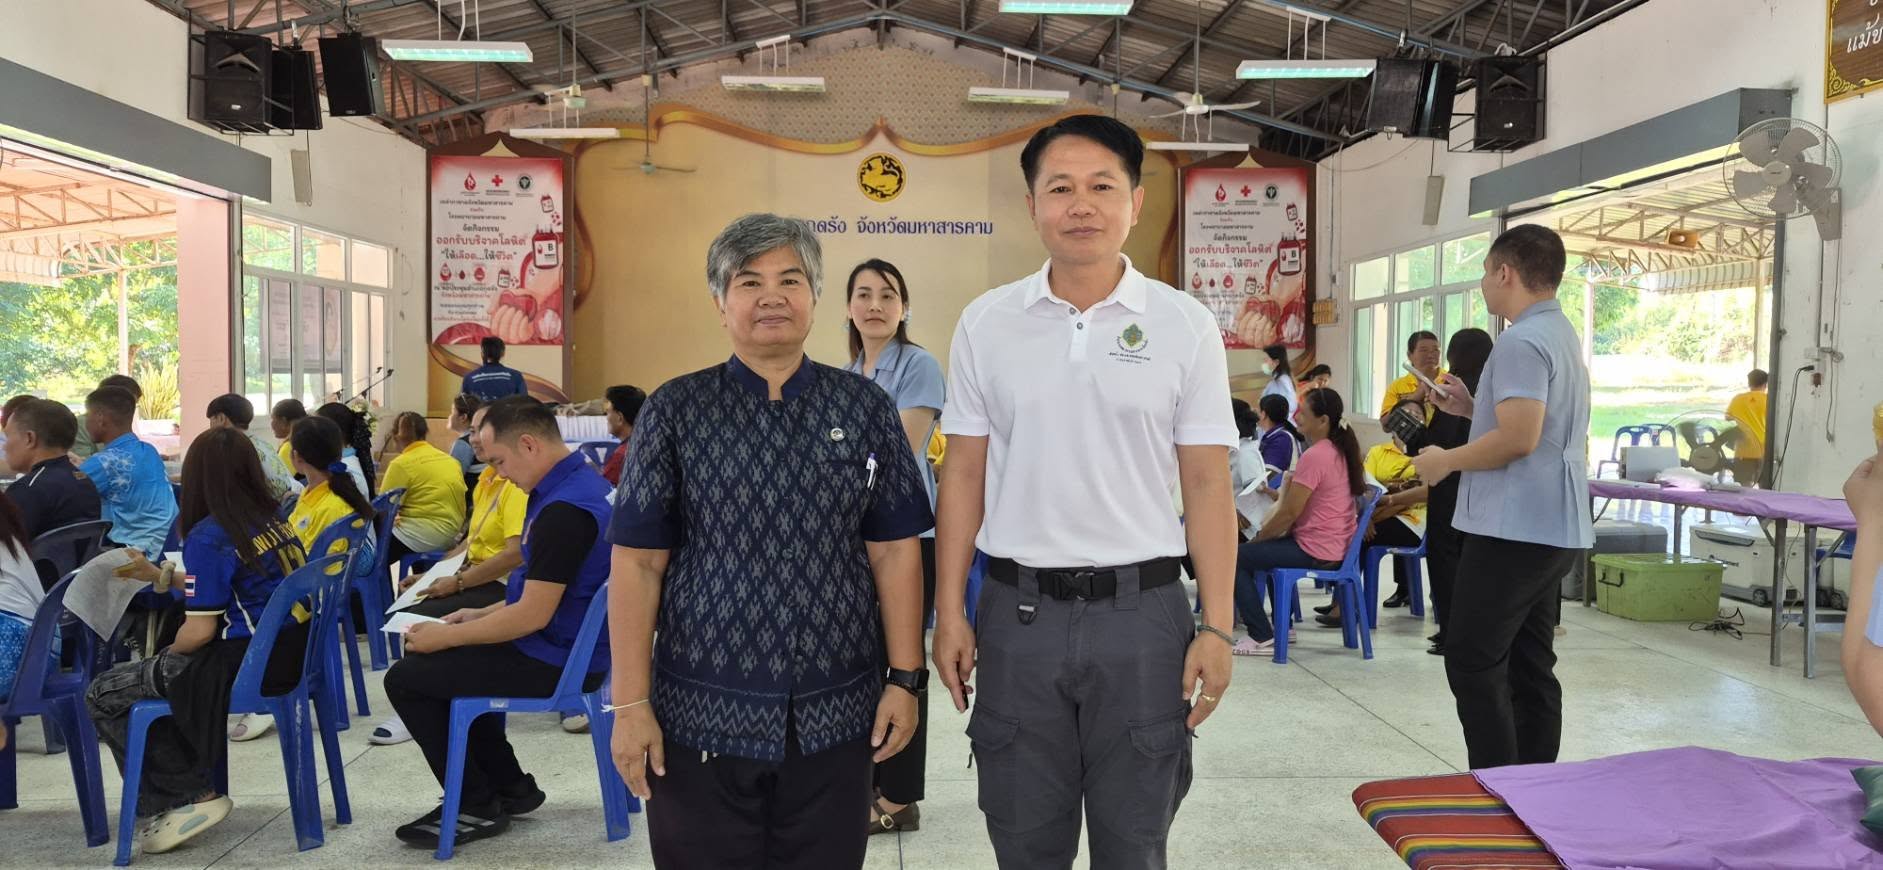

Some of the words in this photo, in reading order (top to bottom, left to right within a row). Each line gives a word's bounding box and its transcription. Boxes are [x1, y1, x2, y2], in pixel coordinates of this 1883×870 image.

[462, 223, 500, 232] จัดกิจกรรม
[857, 216, 993, 235] จังหวัดมหาสารคาม
[436, 233, 526, 246] ออกรับบริจาคโลหิต
[1213, 233, 1248, 241] จัดกิจกรรม
[1189, 242, 1272, 254] ออกรับบริจาคโลหิต
